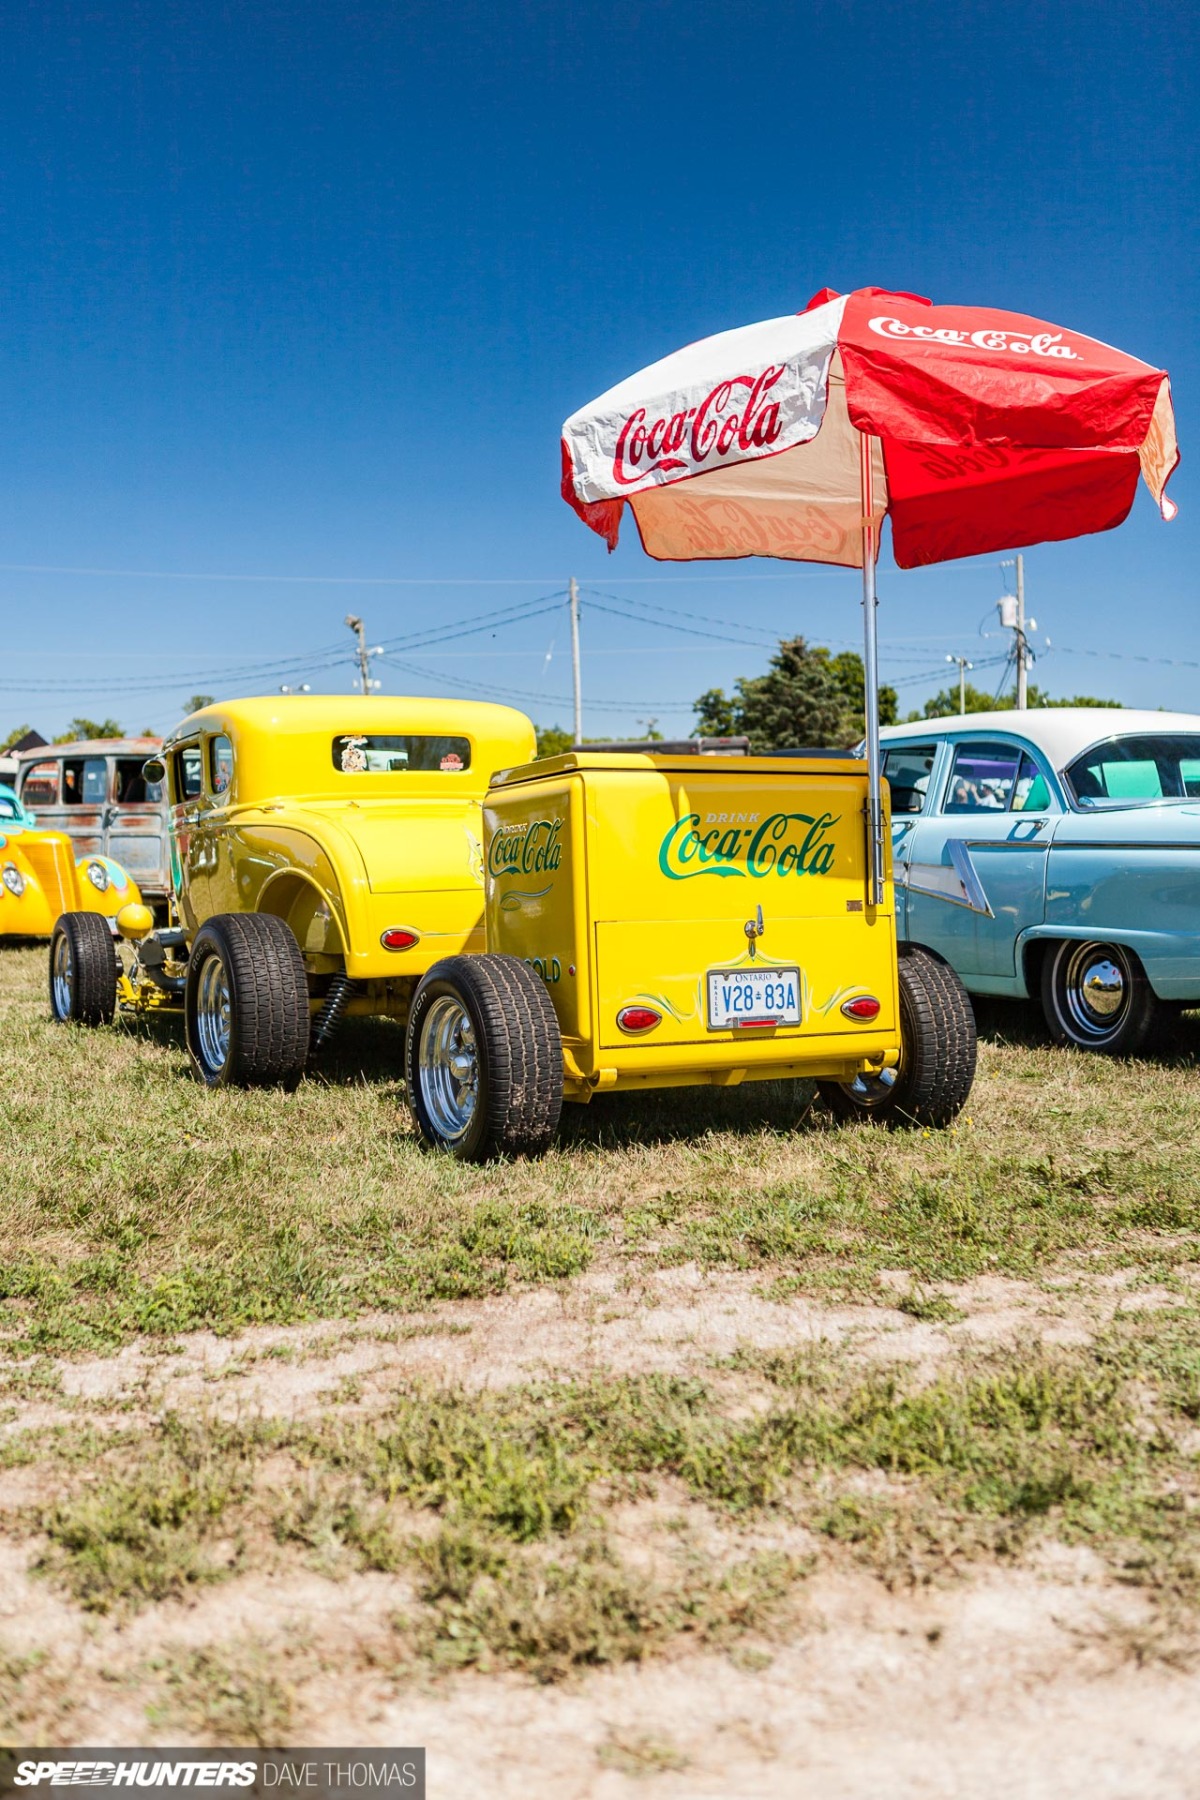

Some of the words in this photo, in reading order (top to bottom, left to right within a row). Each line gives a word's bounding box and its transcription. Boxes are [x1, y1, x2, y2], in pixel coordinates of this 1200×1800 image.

[868, 316, 1078, 360] Coca-Cola
[612, 362, 787, 485] Coca-Cola
[705, 812, 761, 824] DRINK
[488, 818, 565, 878] Coca-Cola
[658, 812, 842, 880] Coca-Cola
[524, 957, 561, 983] OLD
[722, 984, 753, 1013] V28
[765, 983, 796, 1010] 83A
